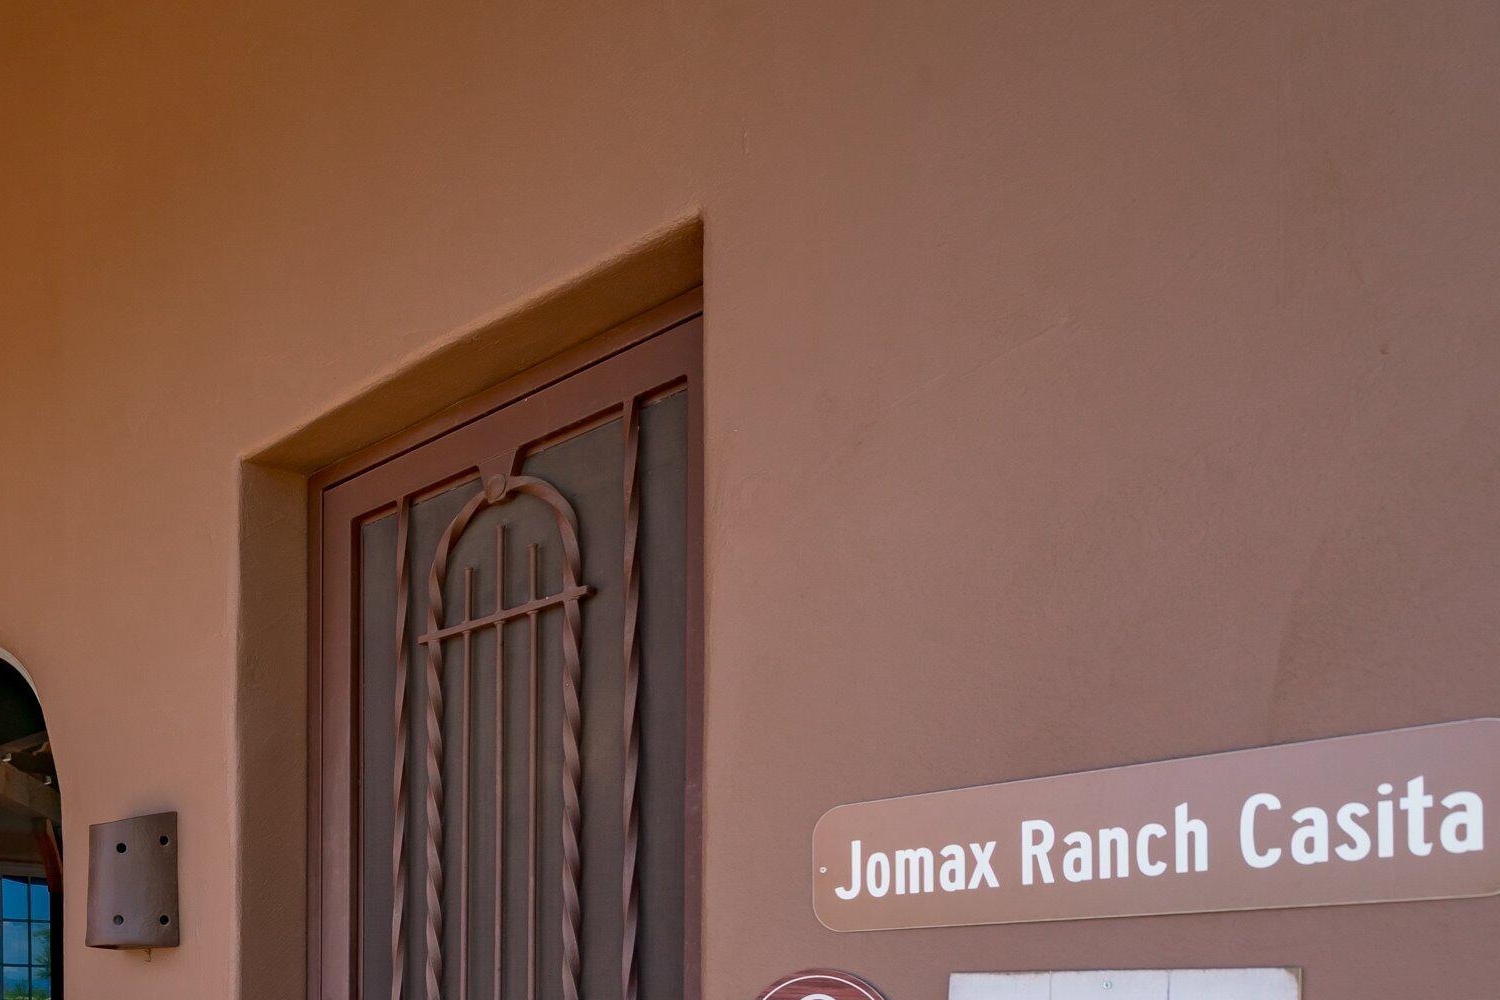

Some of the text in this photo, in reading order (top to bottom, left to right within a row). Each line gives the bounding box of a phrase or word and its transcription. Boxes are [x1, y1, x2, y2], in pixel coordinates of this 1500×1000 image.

[834, 775, 1485, 900] Jomax Ranch Casita
